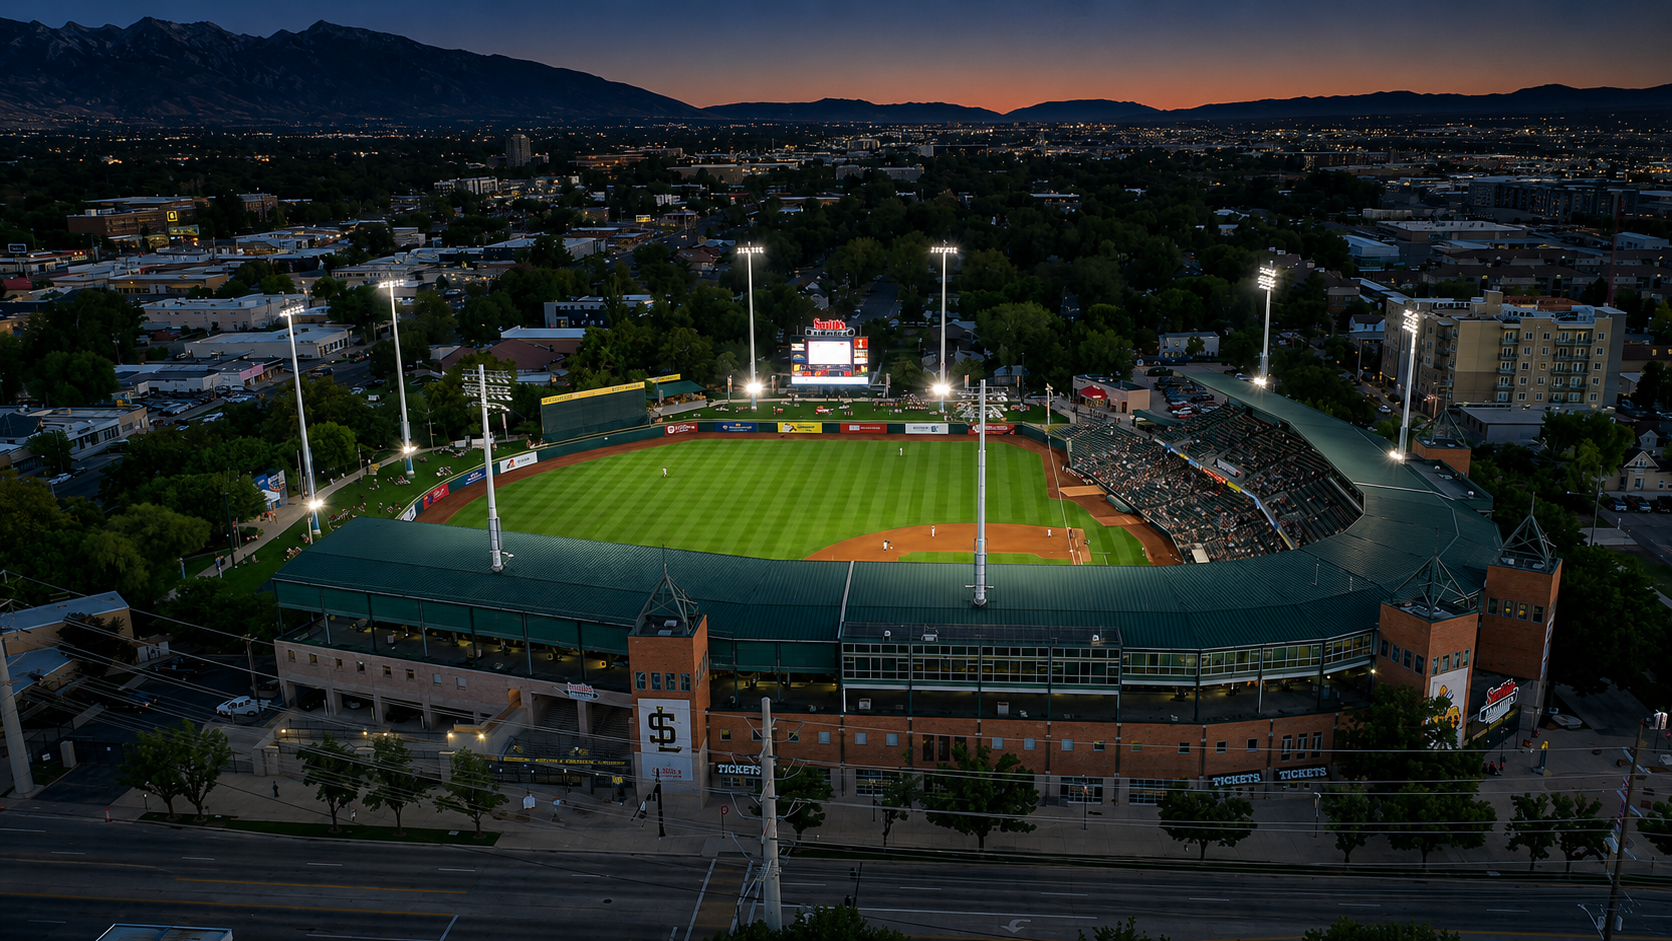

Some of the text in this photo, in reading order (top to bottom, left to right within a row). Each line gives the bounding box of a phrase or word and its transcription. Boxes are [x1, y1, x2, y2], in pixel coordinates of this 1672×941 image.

[717, 764, 762, 775] TICKETS
[1279, 767, 1328, 780] TICKETS
[1212, 773, 1261, 787] TICKETS
